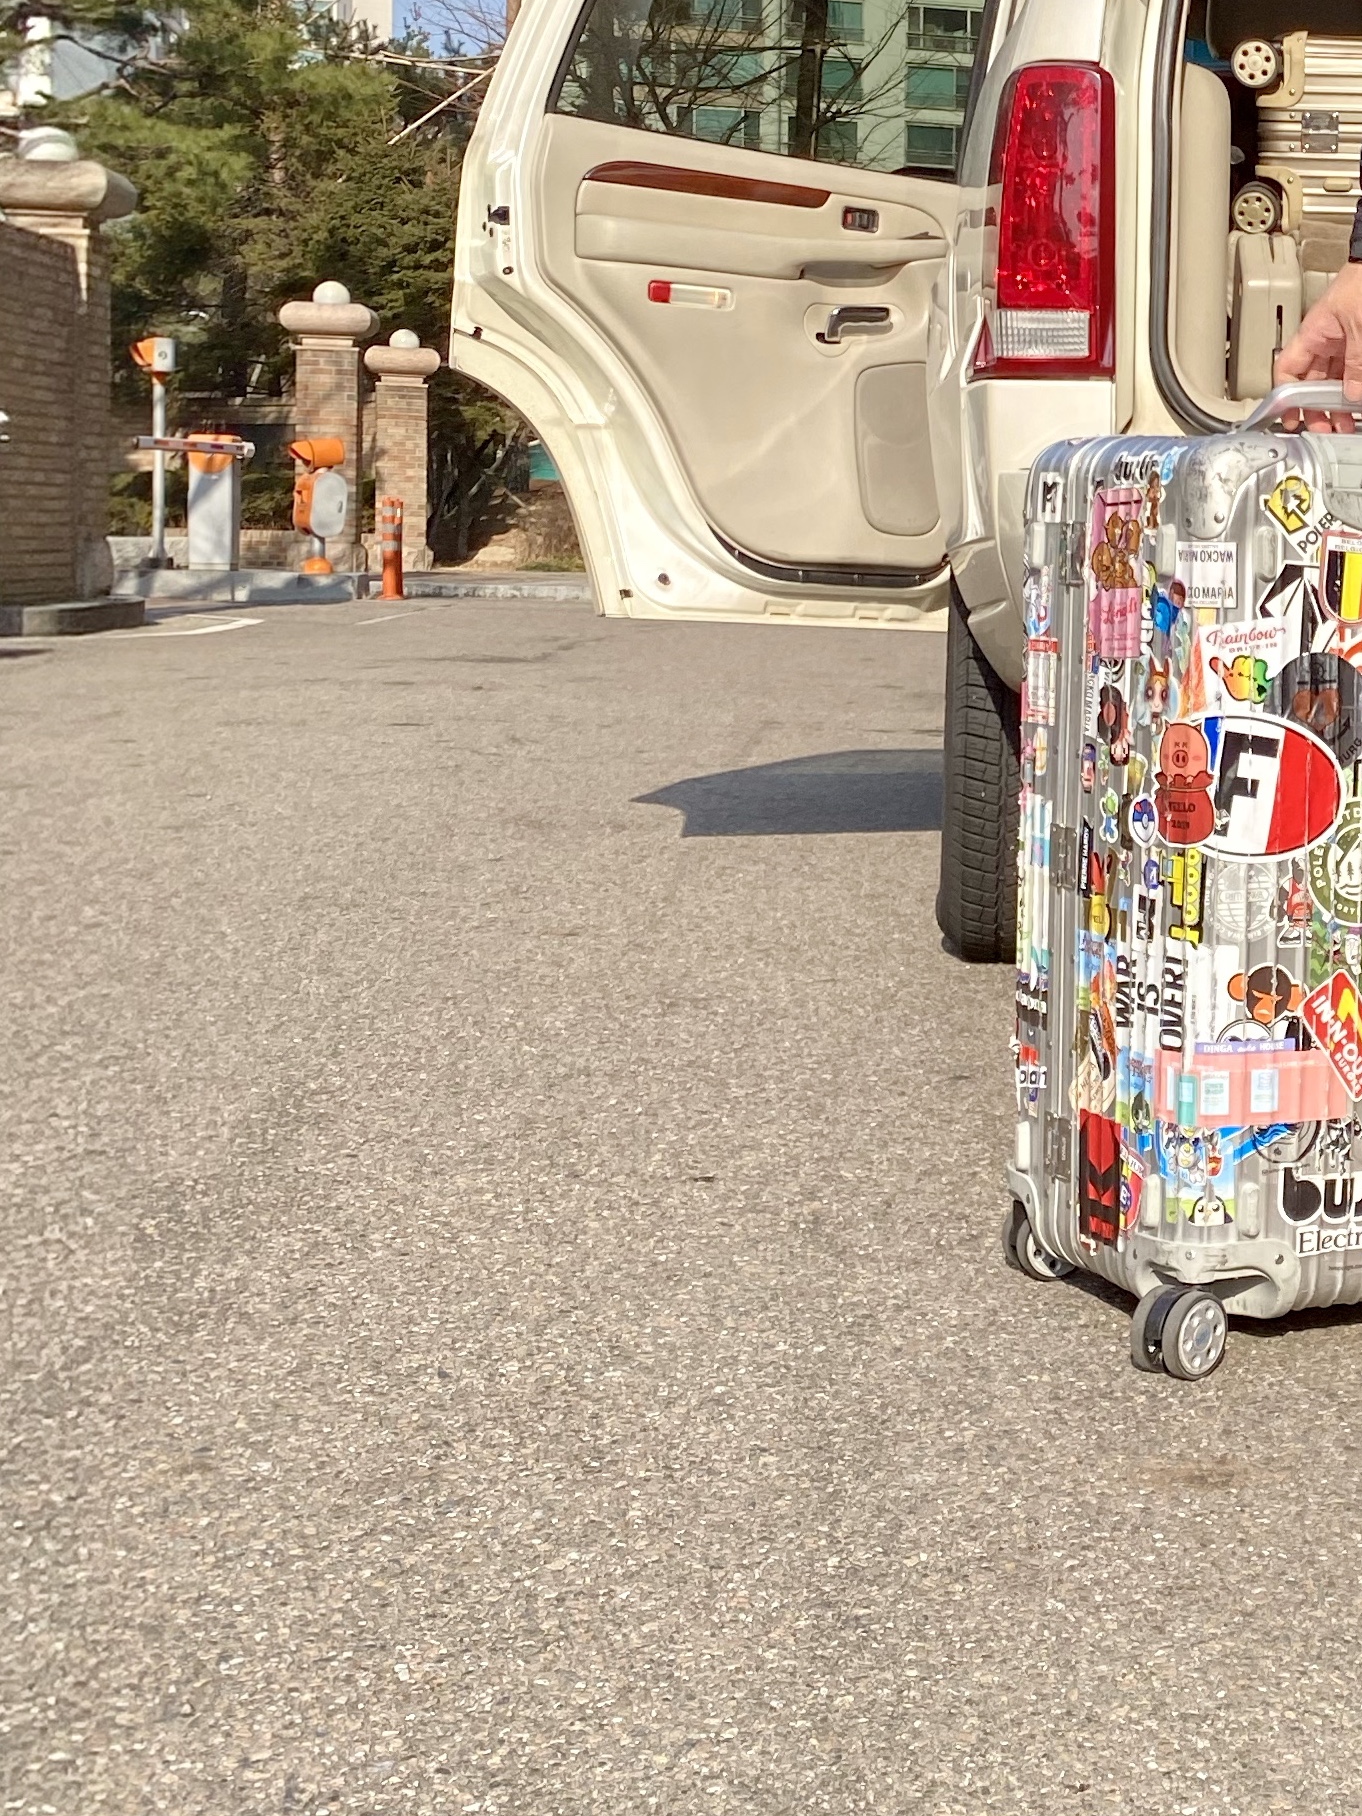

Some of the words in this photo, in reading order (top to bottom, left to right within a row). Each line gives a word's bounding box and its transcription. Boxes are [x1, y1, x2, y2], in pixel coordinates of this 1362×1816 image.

[1296, 512, 1337, 555] POLER
[1206, 626, 1286, 650] Rainbow
[1214, 731, 1281, 838] F
[1225, 890, 1264, 900] RIMWA
[1116, 955, 1137, 1029] WAR
[1137, 981, 1160, 1016] IS
[1159, 956, 1188, 1053] OVER!
[1203, 1044, 1233, 1053] DINGA
